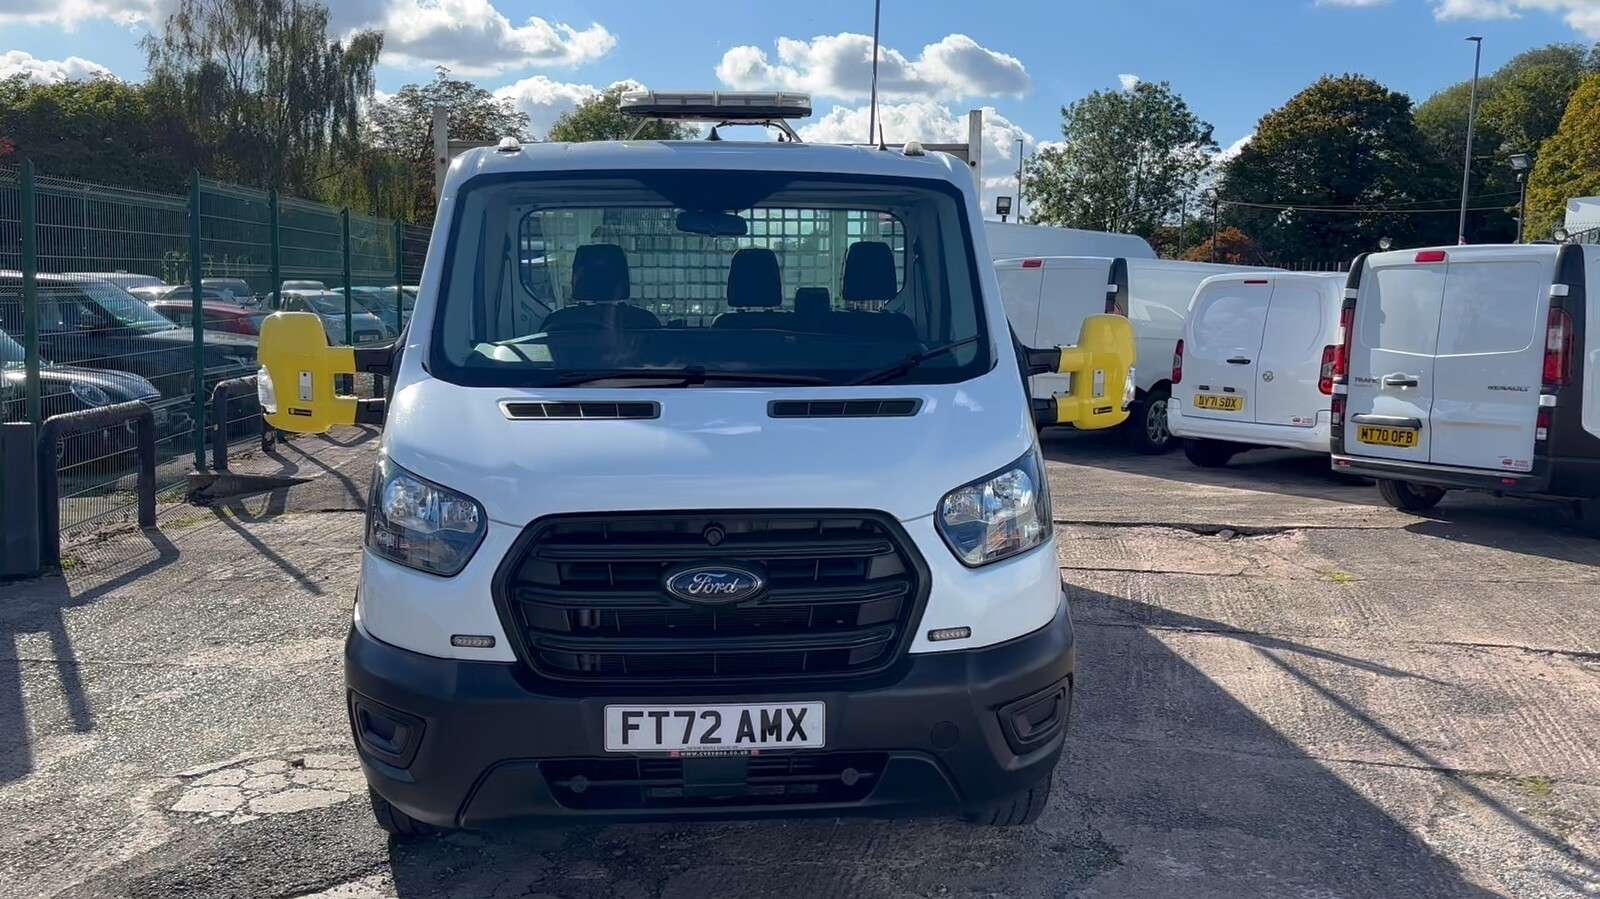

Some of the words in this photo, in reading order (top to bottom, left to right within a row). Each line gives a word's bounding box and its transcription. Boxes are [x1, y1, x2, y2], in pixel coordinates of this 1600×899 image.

[688, 572, 740, 594] Ford
[621, 710, 722, 745] FT72
[735, 707, 808, 744] AMX
